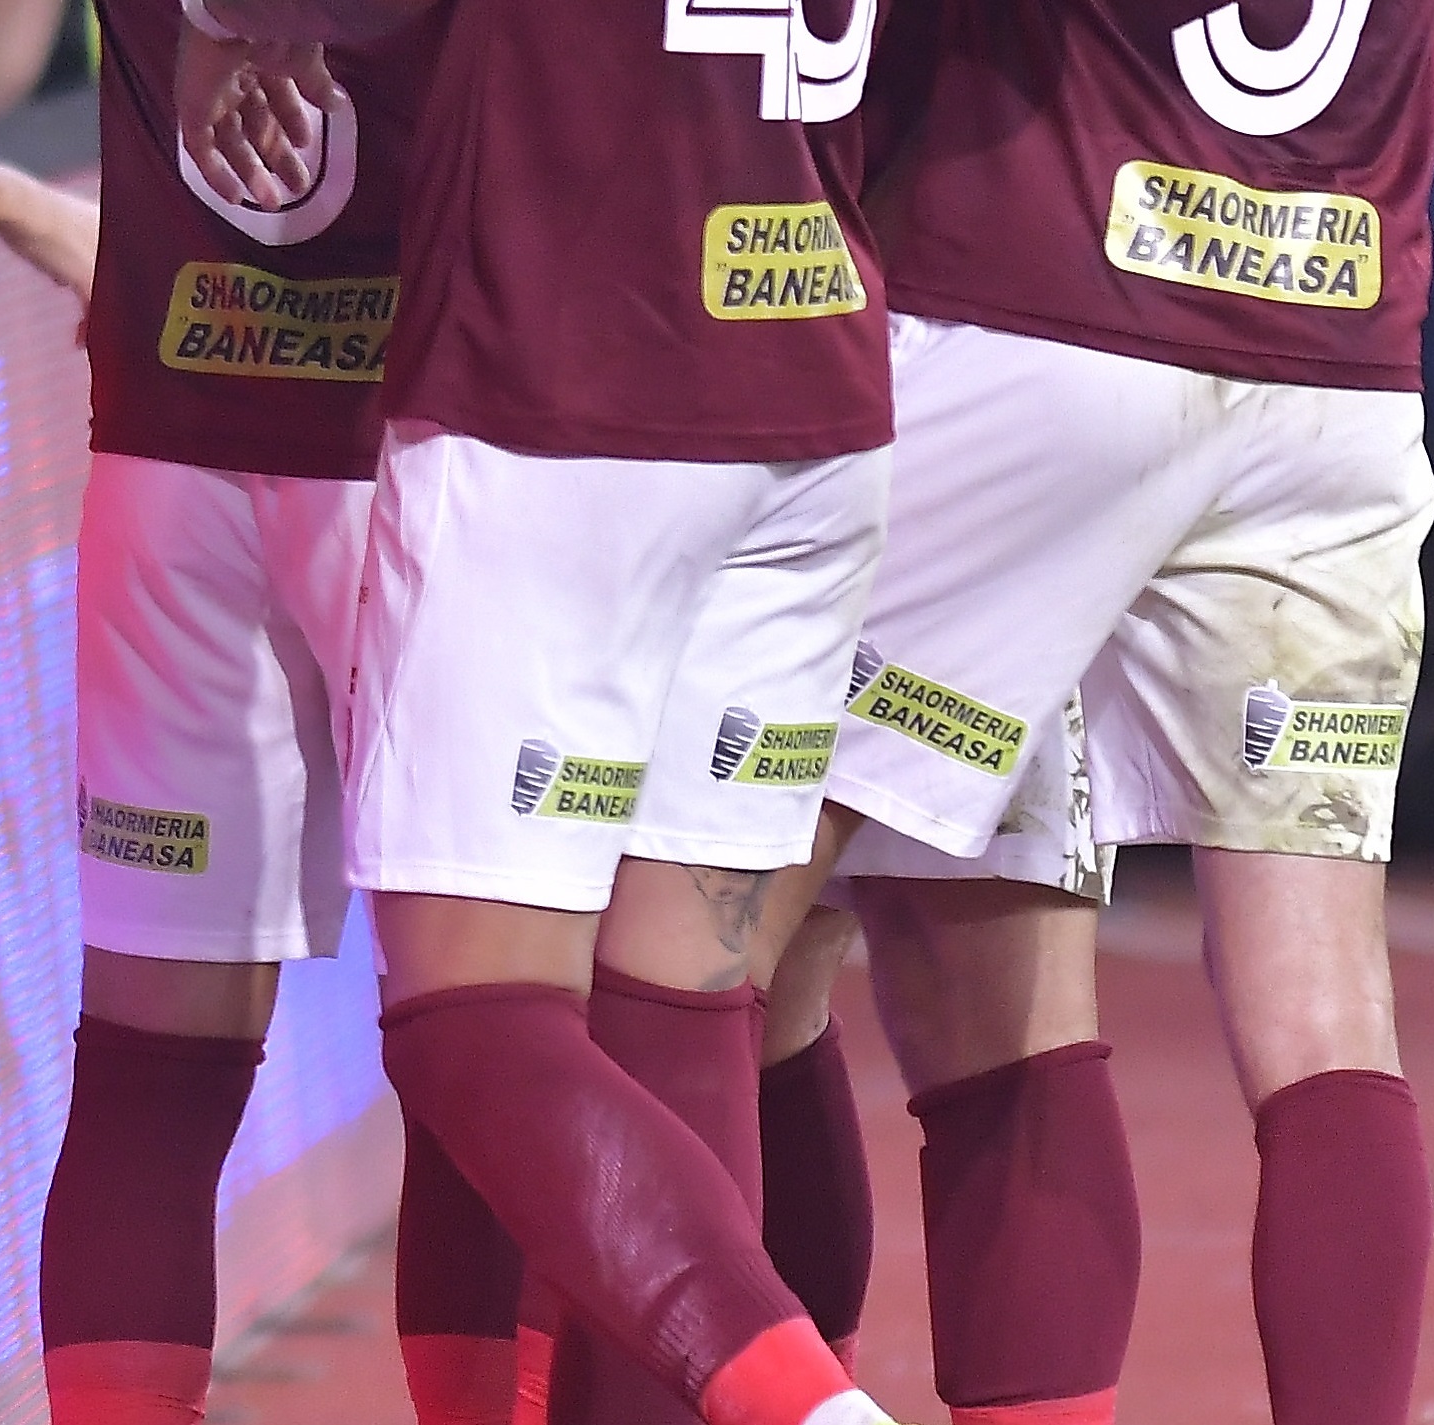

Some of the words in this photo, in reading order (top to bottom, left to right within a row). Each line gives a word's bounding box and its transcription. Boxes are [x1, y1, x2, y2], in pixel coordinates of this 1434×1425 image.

[1137, 175, 1373, 248] SHAORMERIA
[189, 273, 396, 324] SHAORMERI
[880, 670, 1024, 747] SHAORMERIA
